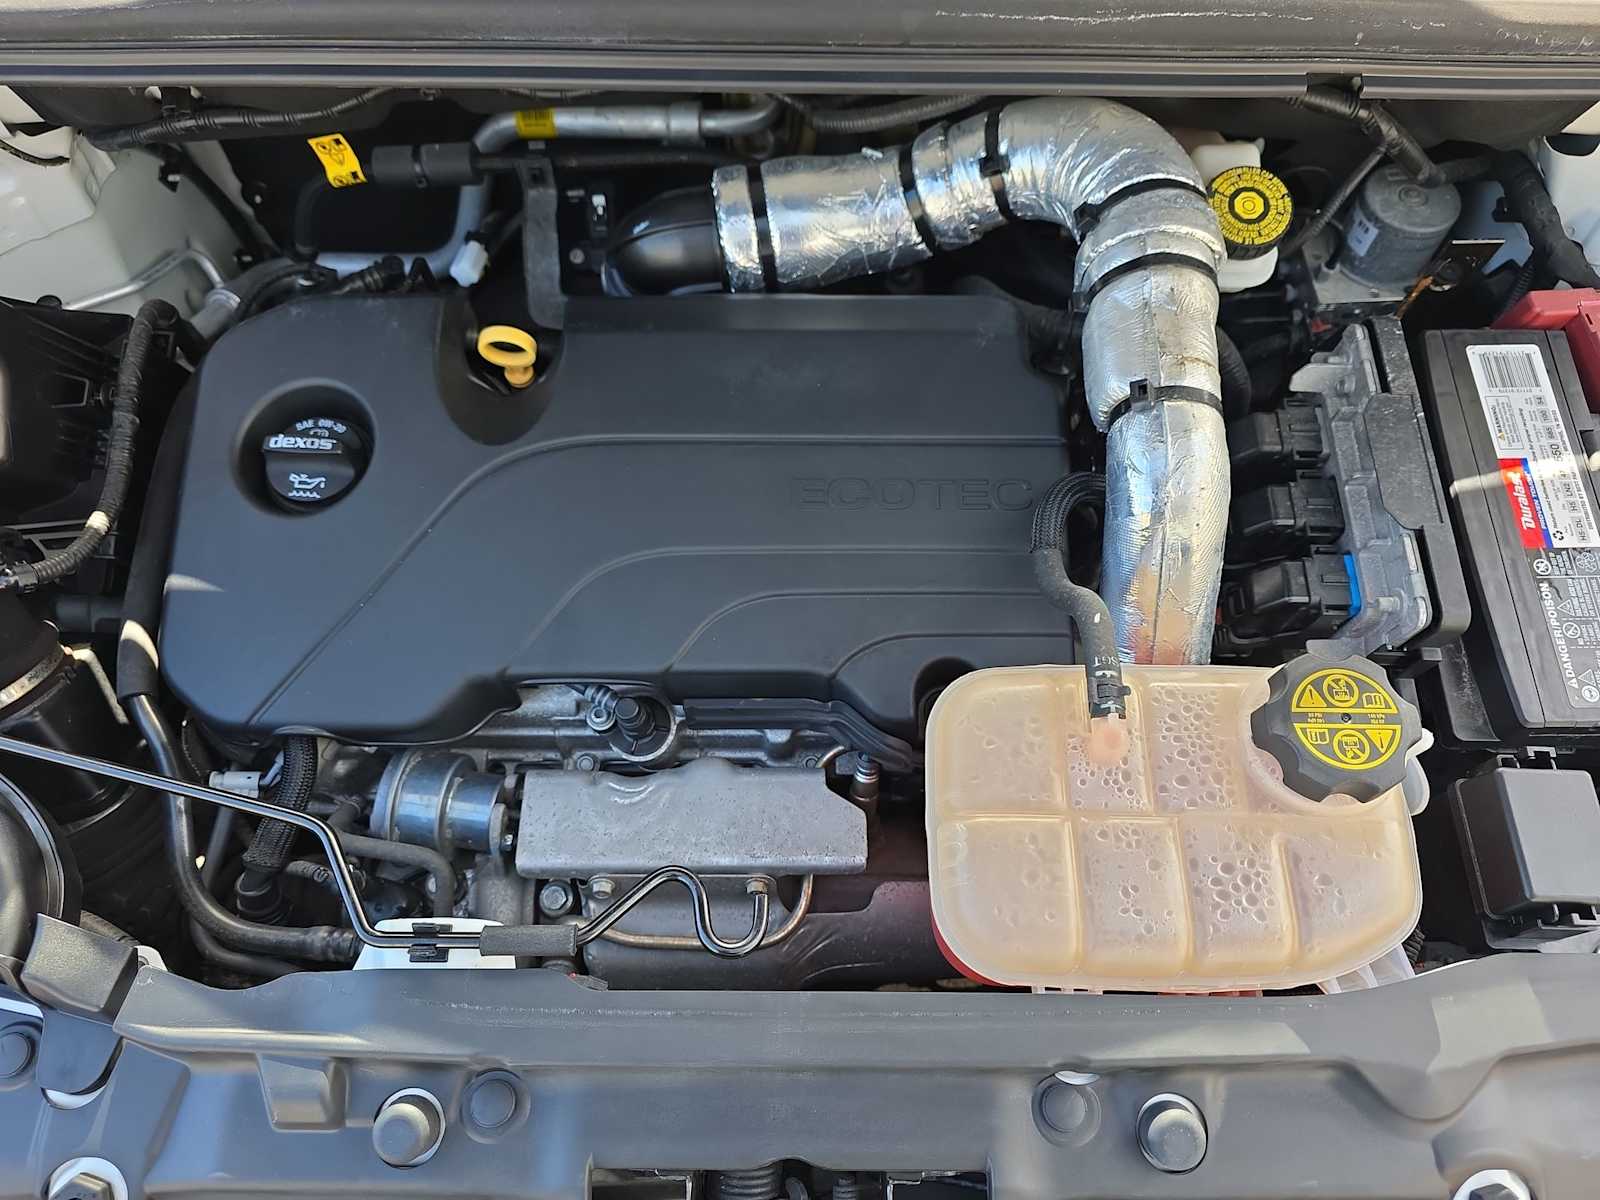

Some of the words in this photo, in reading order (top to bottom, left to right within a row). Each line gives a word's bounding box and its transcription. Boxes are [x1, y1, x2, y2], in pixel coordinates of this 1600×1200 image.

[269, 433, 337, 450] dexos
[1506, 471, 1537, 529] Duralast
[1538, 582, 1576, 678] DANGER/POISON
